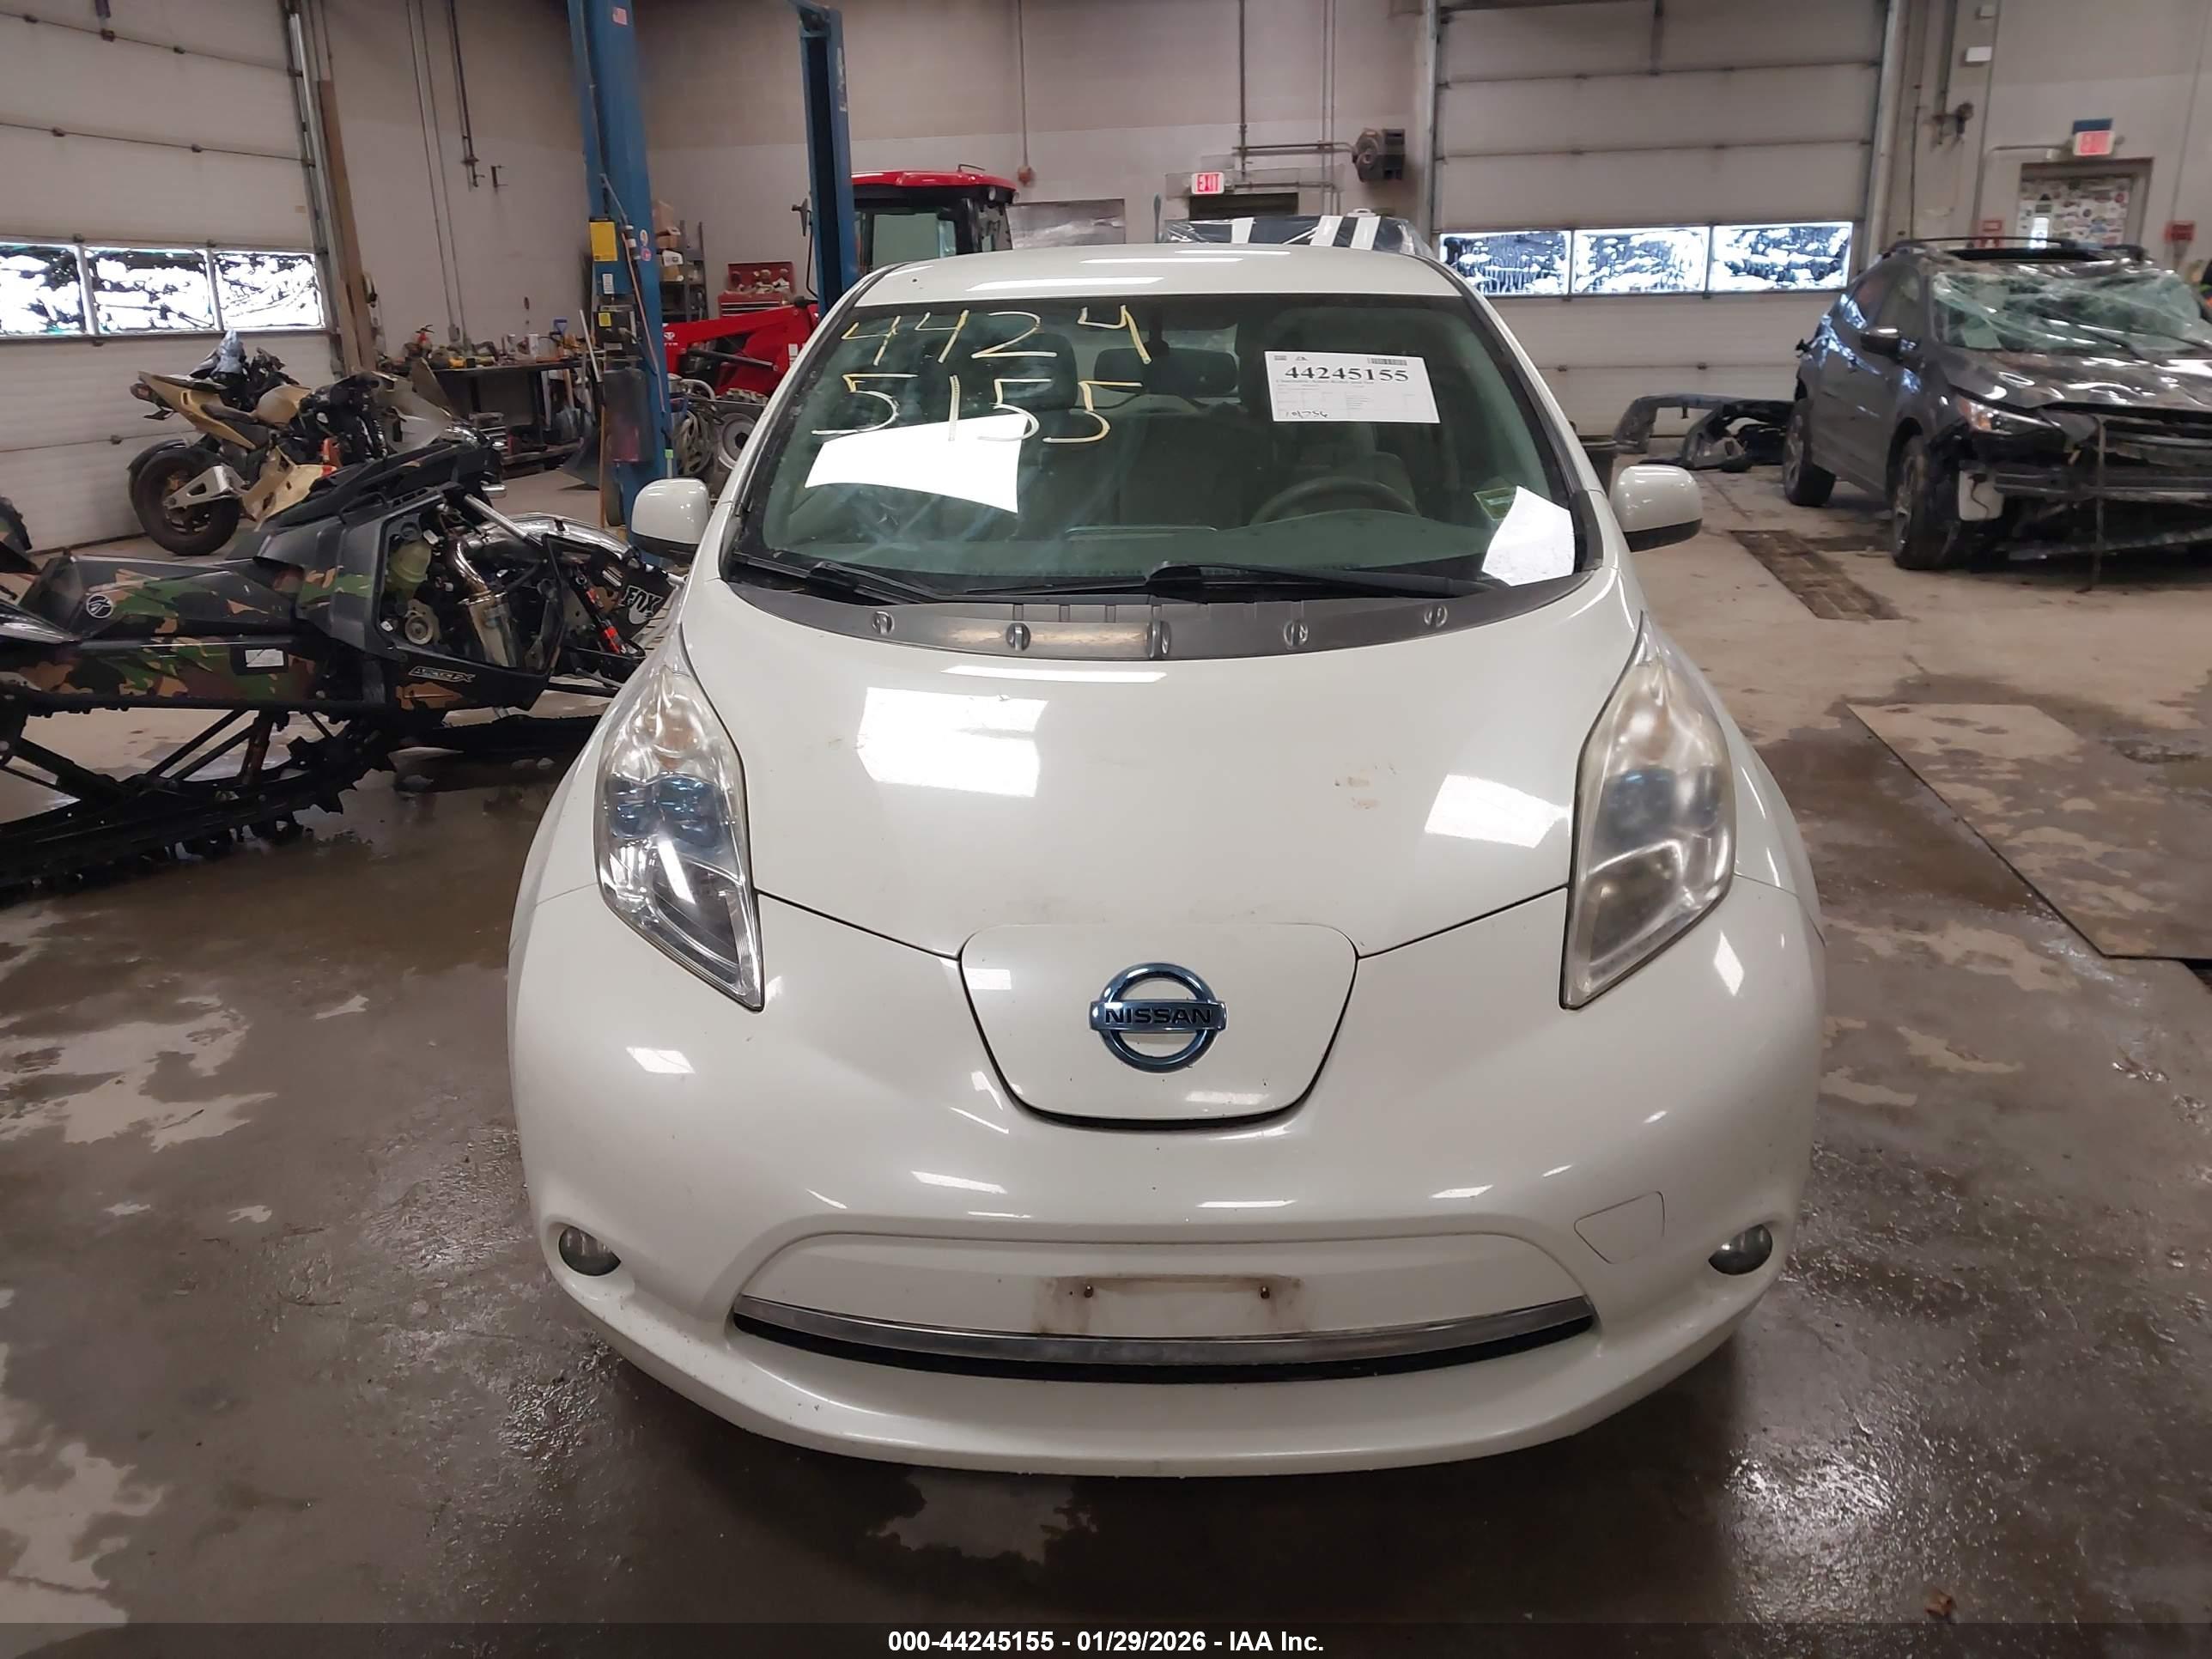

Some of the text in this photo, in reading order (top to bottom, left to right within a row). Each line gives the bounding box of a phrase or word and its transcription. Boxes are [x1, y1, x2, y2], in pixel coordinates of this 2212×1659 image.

[841, 305, 1152, 367] 4424
[1285, 366, 1409, 382] 44245155
[811, 374, 1143, 443] 5155
[623, 585, 664, 617] FOX
[1105, 1008, 1212, 1025] NISSAN
